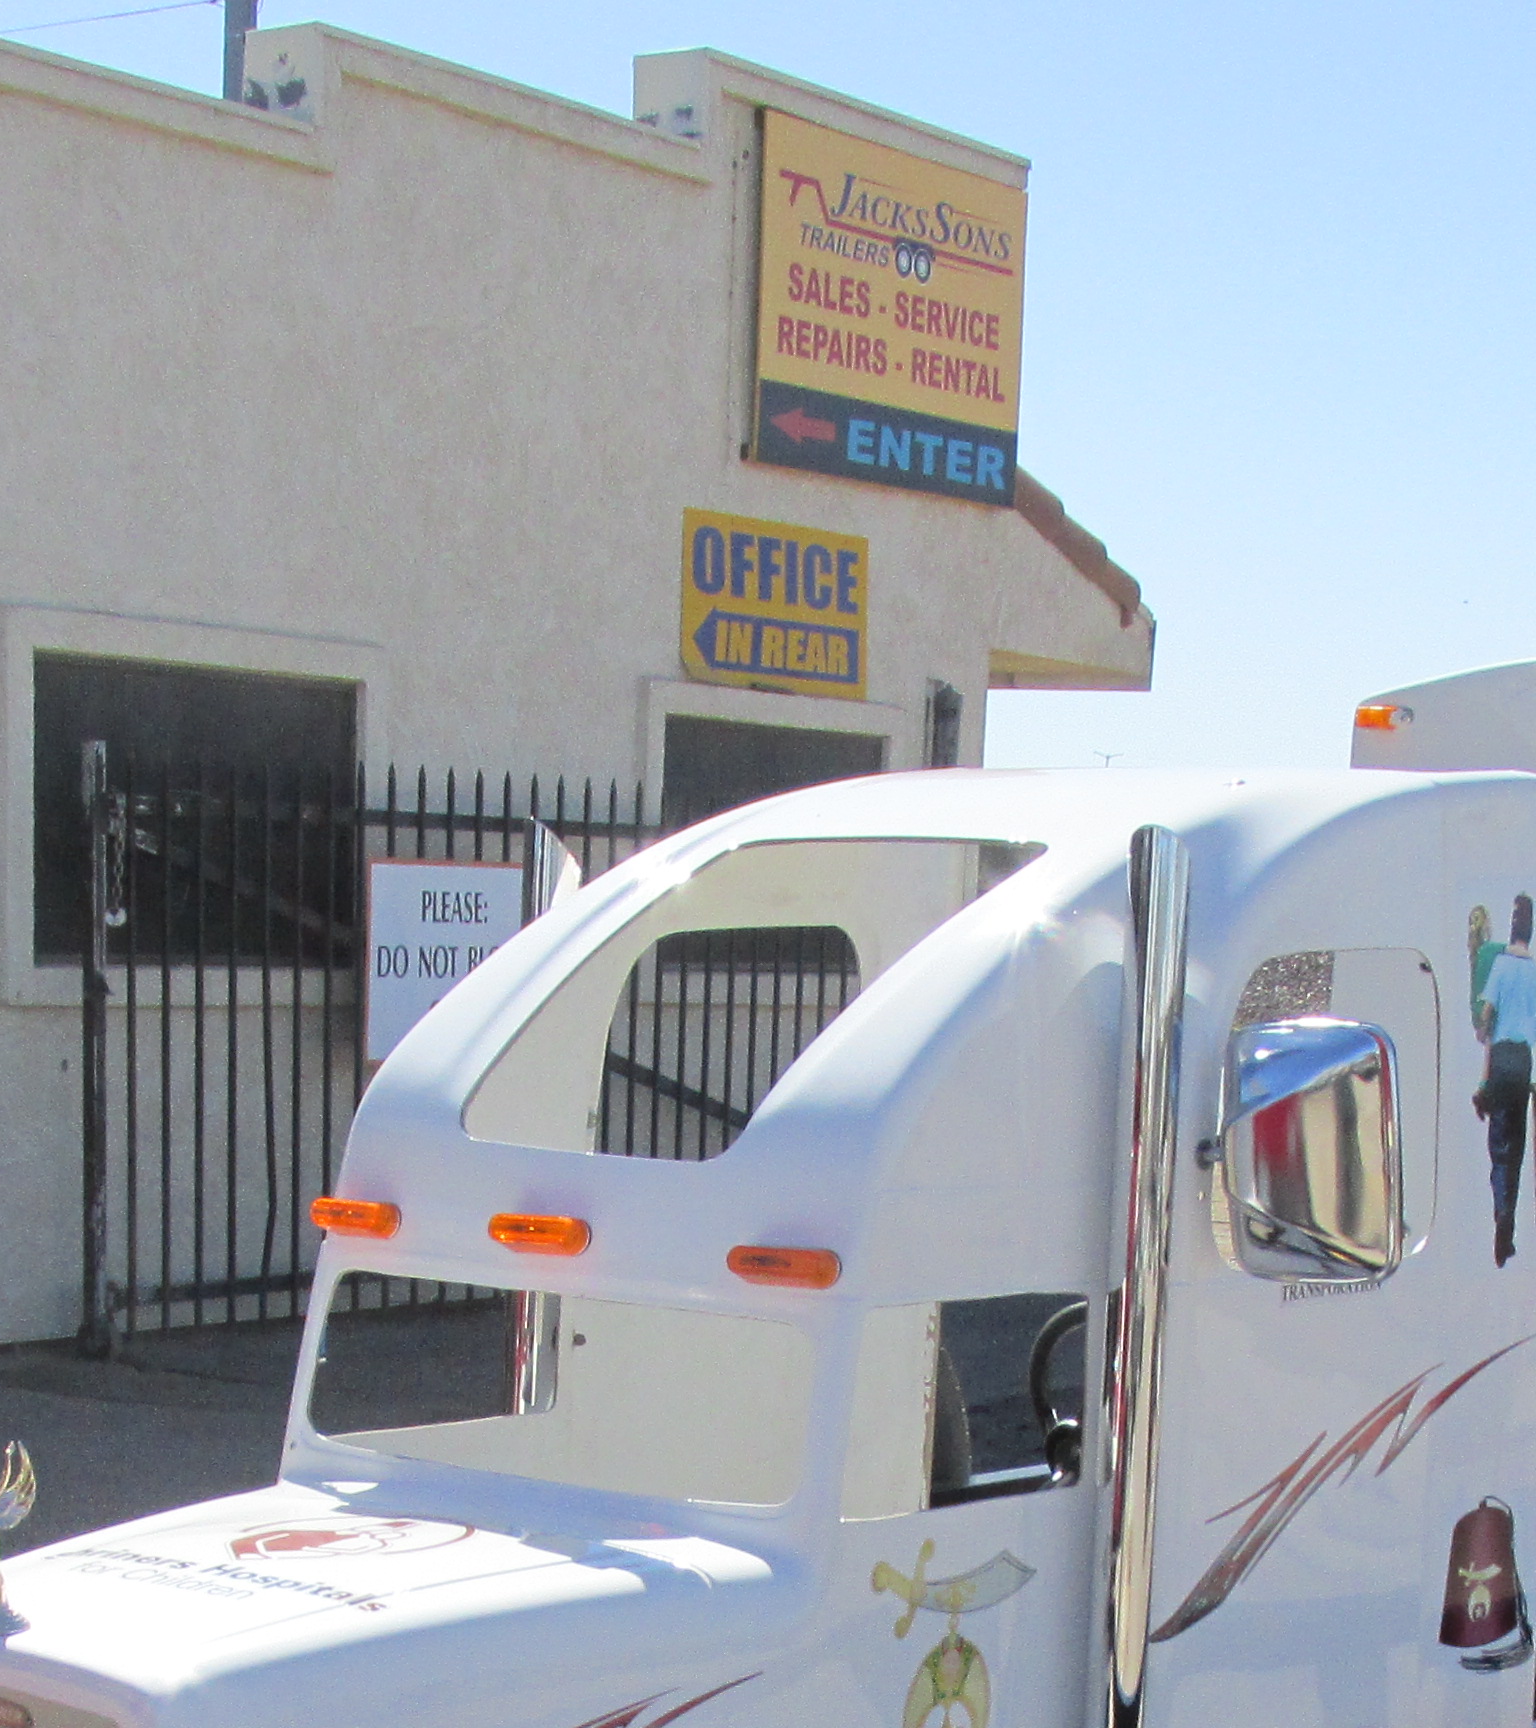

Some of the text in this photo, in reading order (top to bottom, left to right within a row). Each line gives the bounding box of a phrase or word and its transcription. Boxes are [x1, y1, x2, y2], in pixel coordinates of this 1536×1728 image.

[799, 222, 890, 268] TRAILERS
[788, 262, 871, 318] SALES
[894, 290, 1000, 351] SERVICE
[777, 316, 888, 377] REPAIRS
[911, 347, 1006, 403] RENTAL
[845, 417, 1007, 491] ENTER
[692, 526, 859, 614] OFFICE
[714, 618, 850, 677] IN REAR
[421, 889, 489, 924] PLEASE:
[376, 944, 409, 979] DO
[418, 945, 459, 979] NOT
[120, 1567, 256, 1601] Children
[200, 1563, 387, 1613] Hospitals
